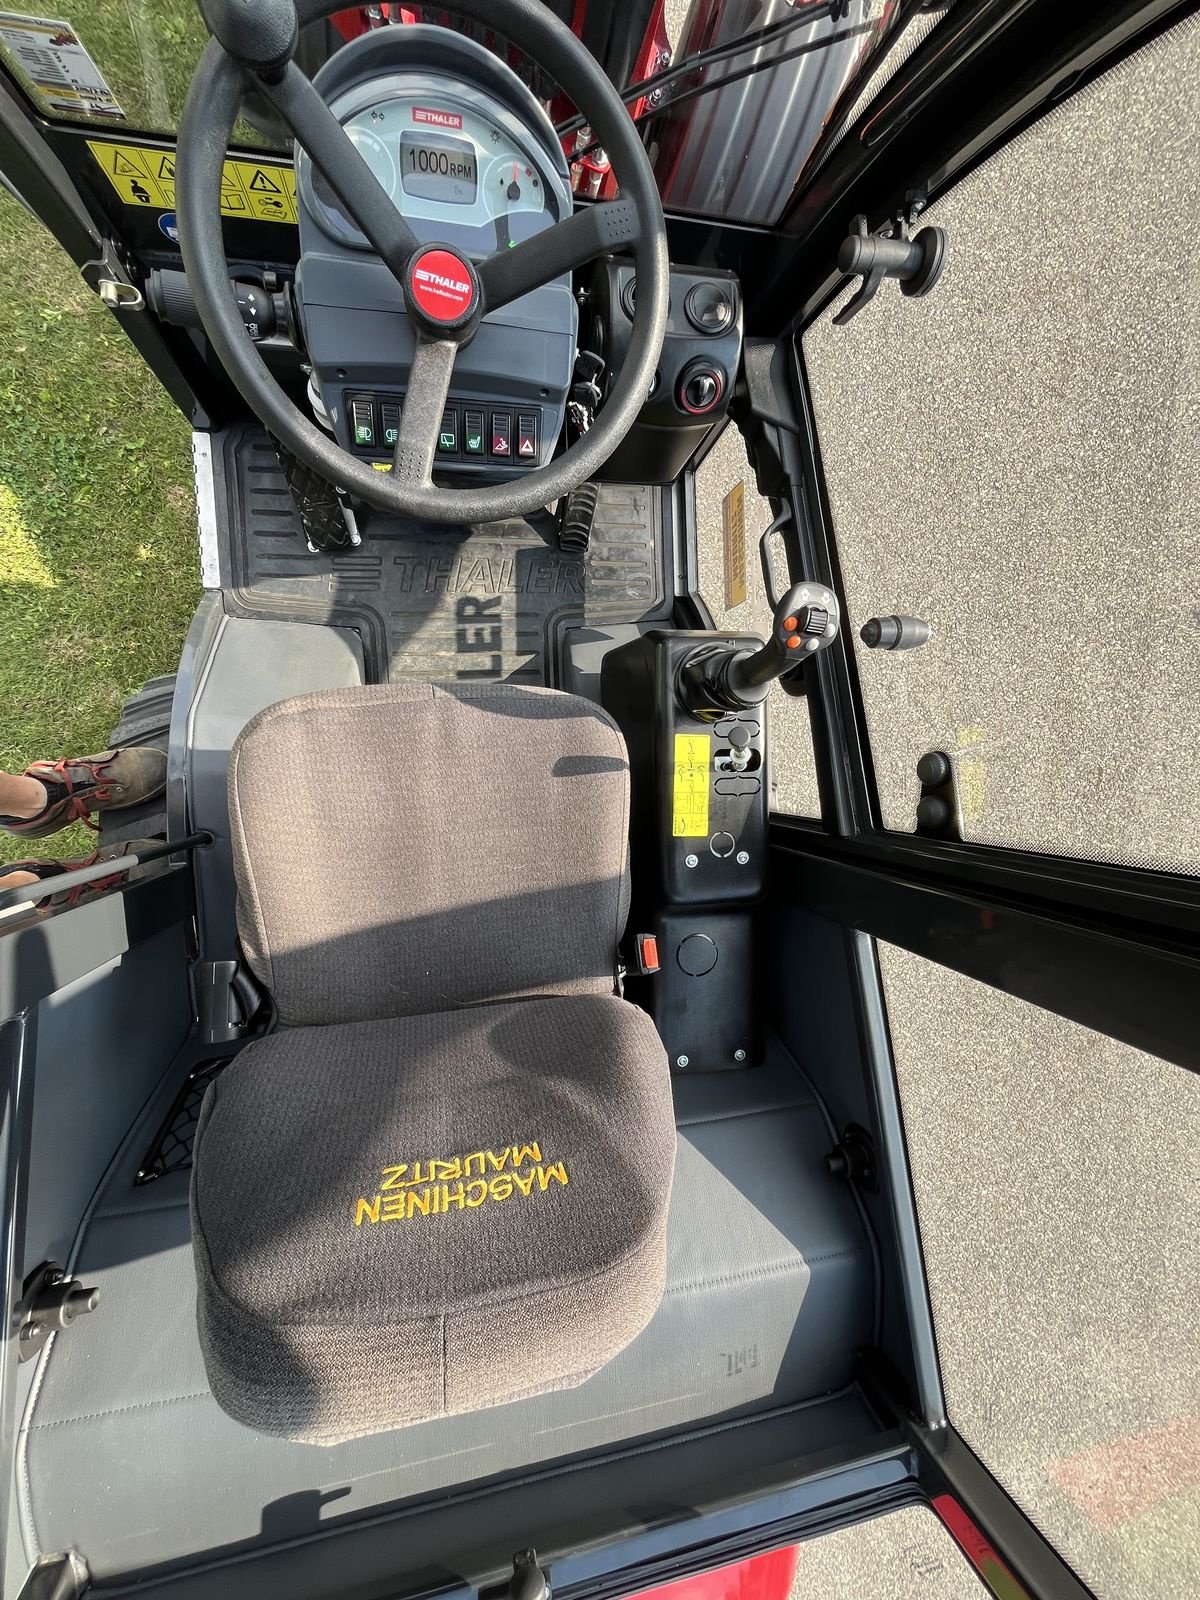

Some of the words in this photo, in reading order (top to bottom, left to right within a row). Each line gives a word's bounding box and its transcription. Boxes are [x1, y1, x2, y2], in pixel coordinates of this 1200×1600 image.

[426, 112, 460, 127] THALER
[409, 148, 449, 175] 1000
[450, 162, 472, 179] RPM
[428, 273, 470, 294] THALER
[394, 556, 587, 595] THALER
[381, 1141, 543, 1191] MAURITZ
[354, 1161, 569, 1226] MASCHINEN
